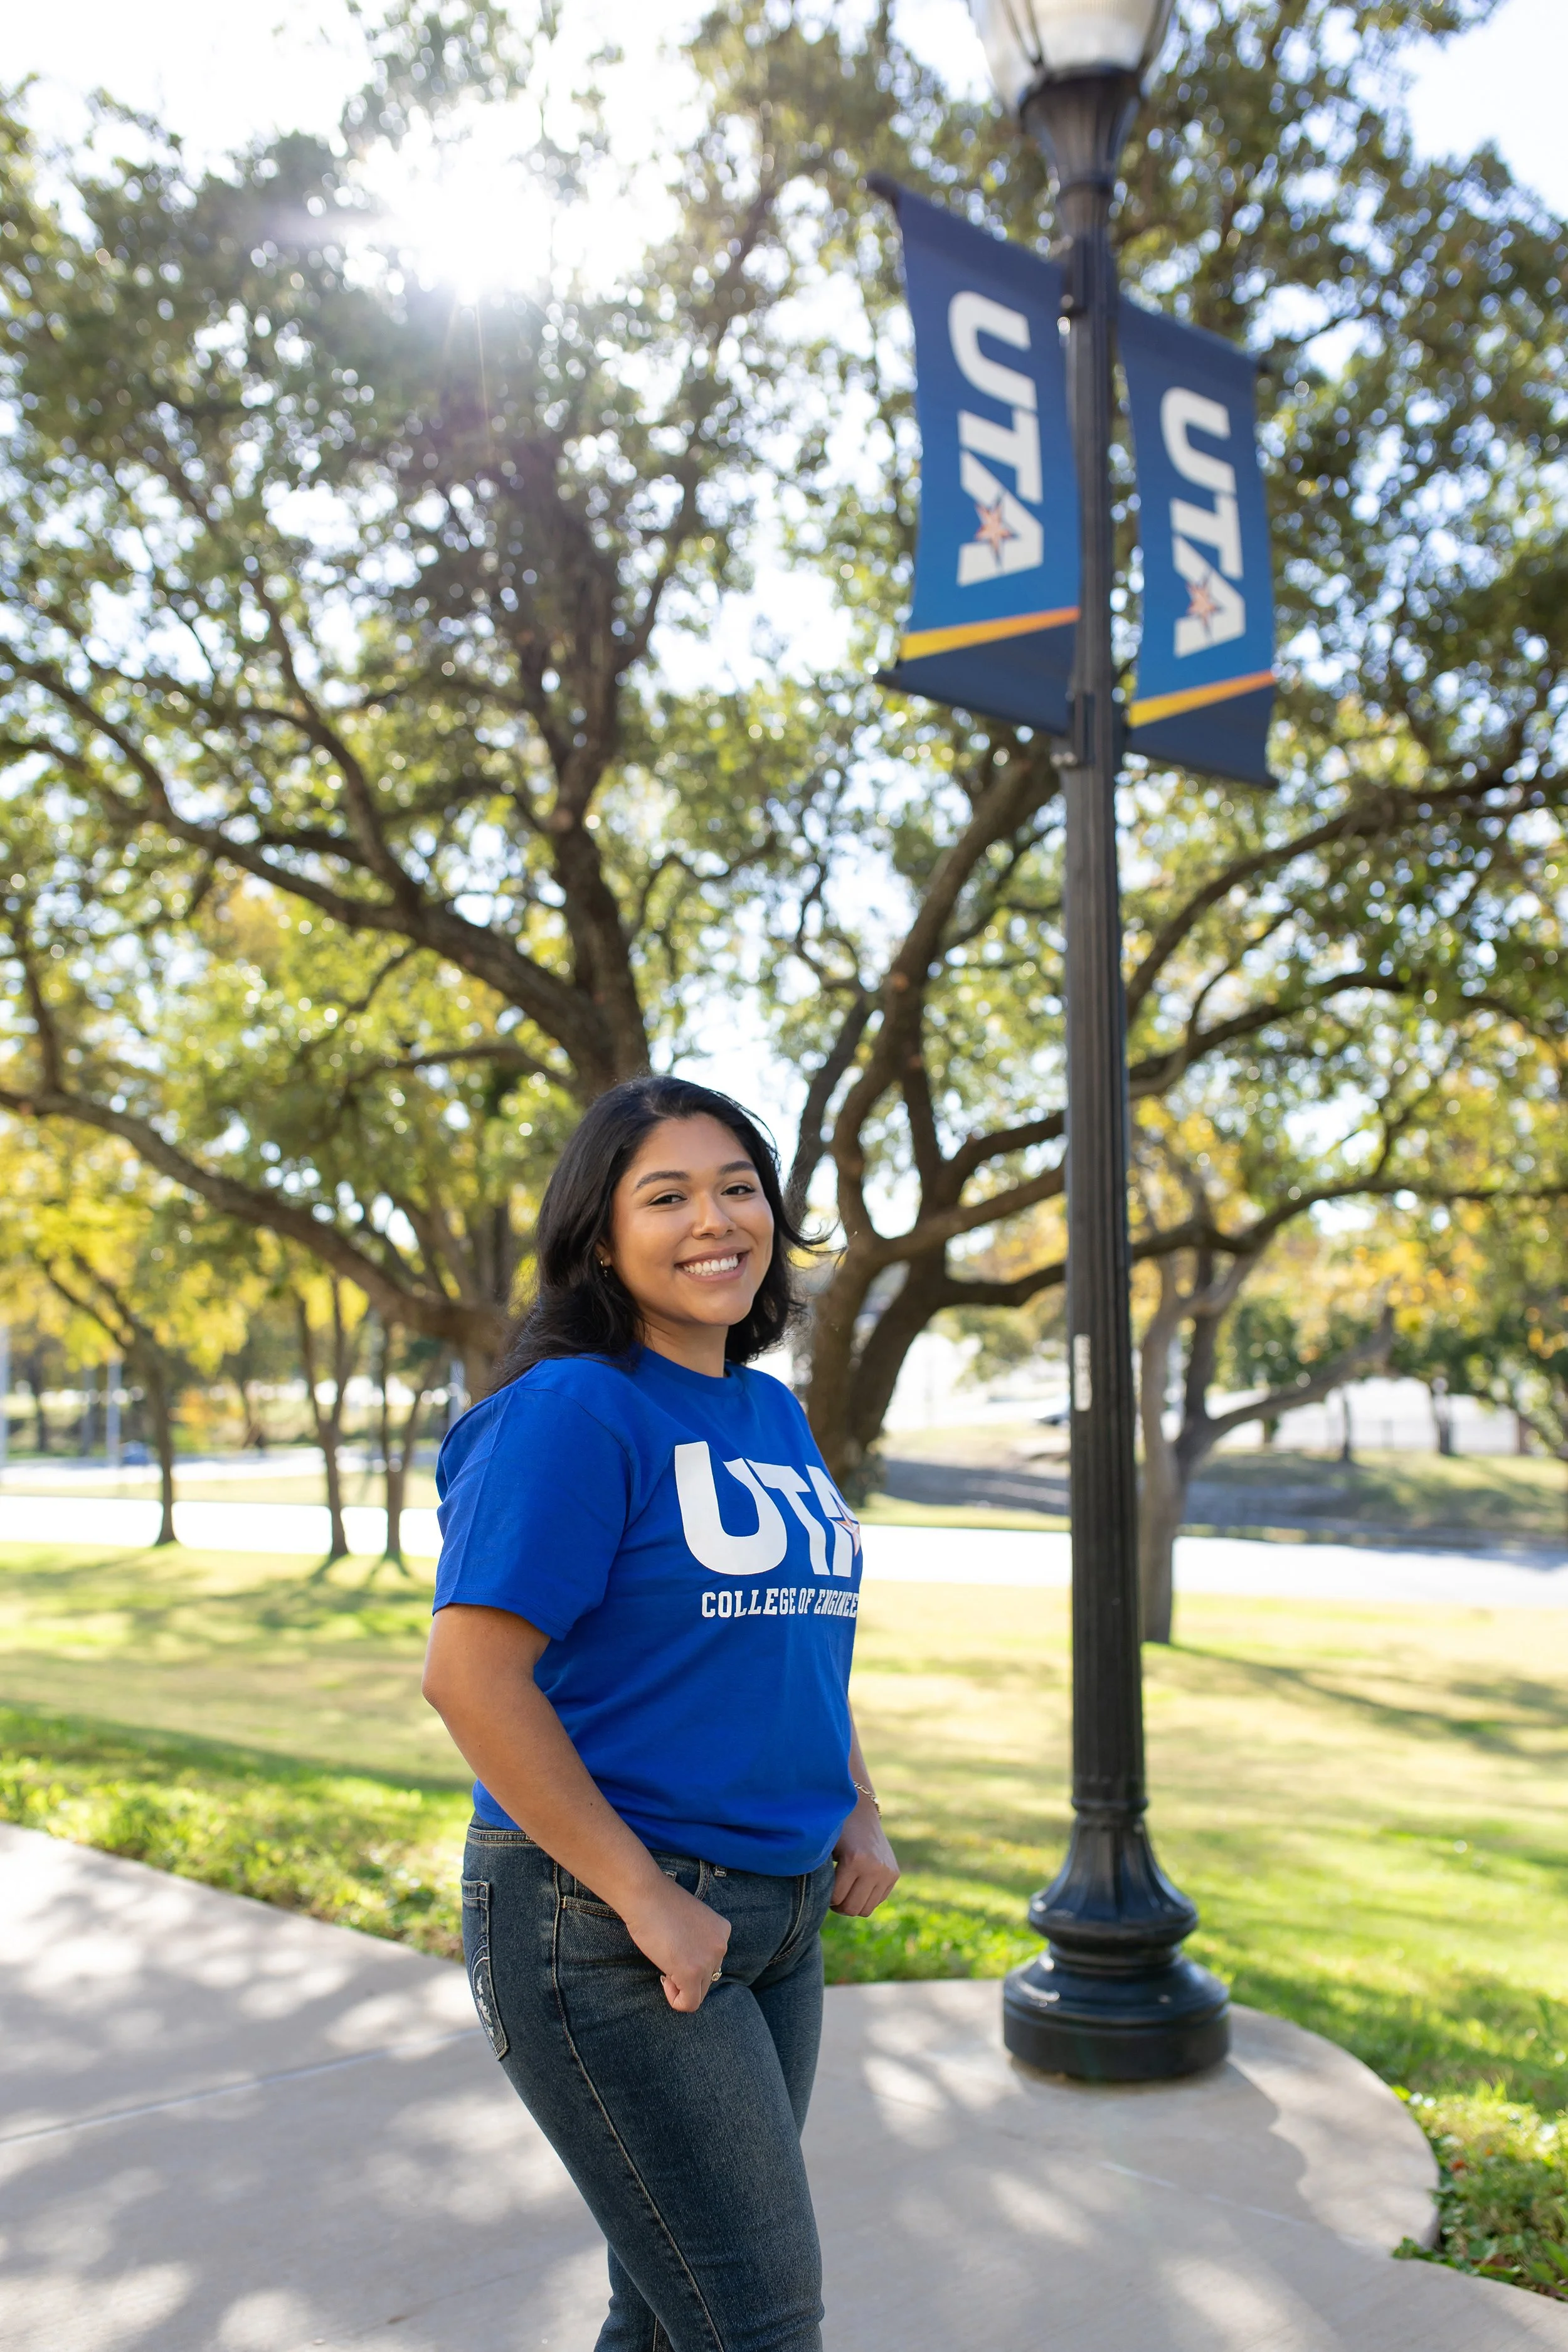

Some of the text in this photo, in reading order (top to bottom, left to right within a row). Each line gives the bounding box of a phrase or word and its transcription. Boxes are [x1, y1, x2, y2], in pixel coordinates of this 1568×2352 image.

[948, 290, 1044, 587] UTA
[1160, 386, 1246, 658] UTA
[701, 1587, 797, 1618] COLLEGE
[797, 1587, 815, 1614] OF
